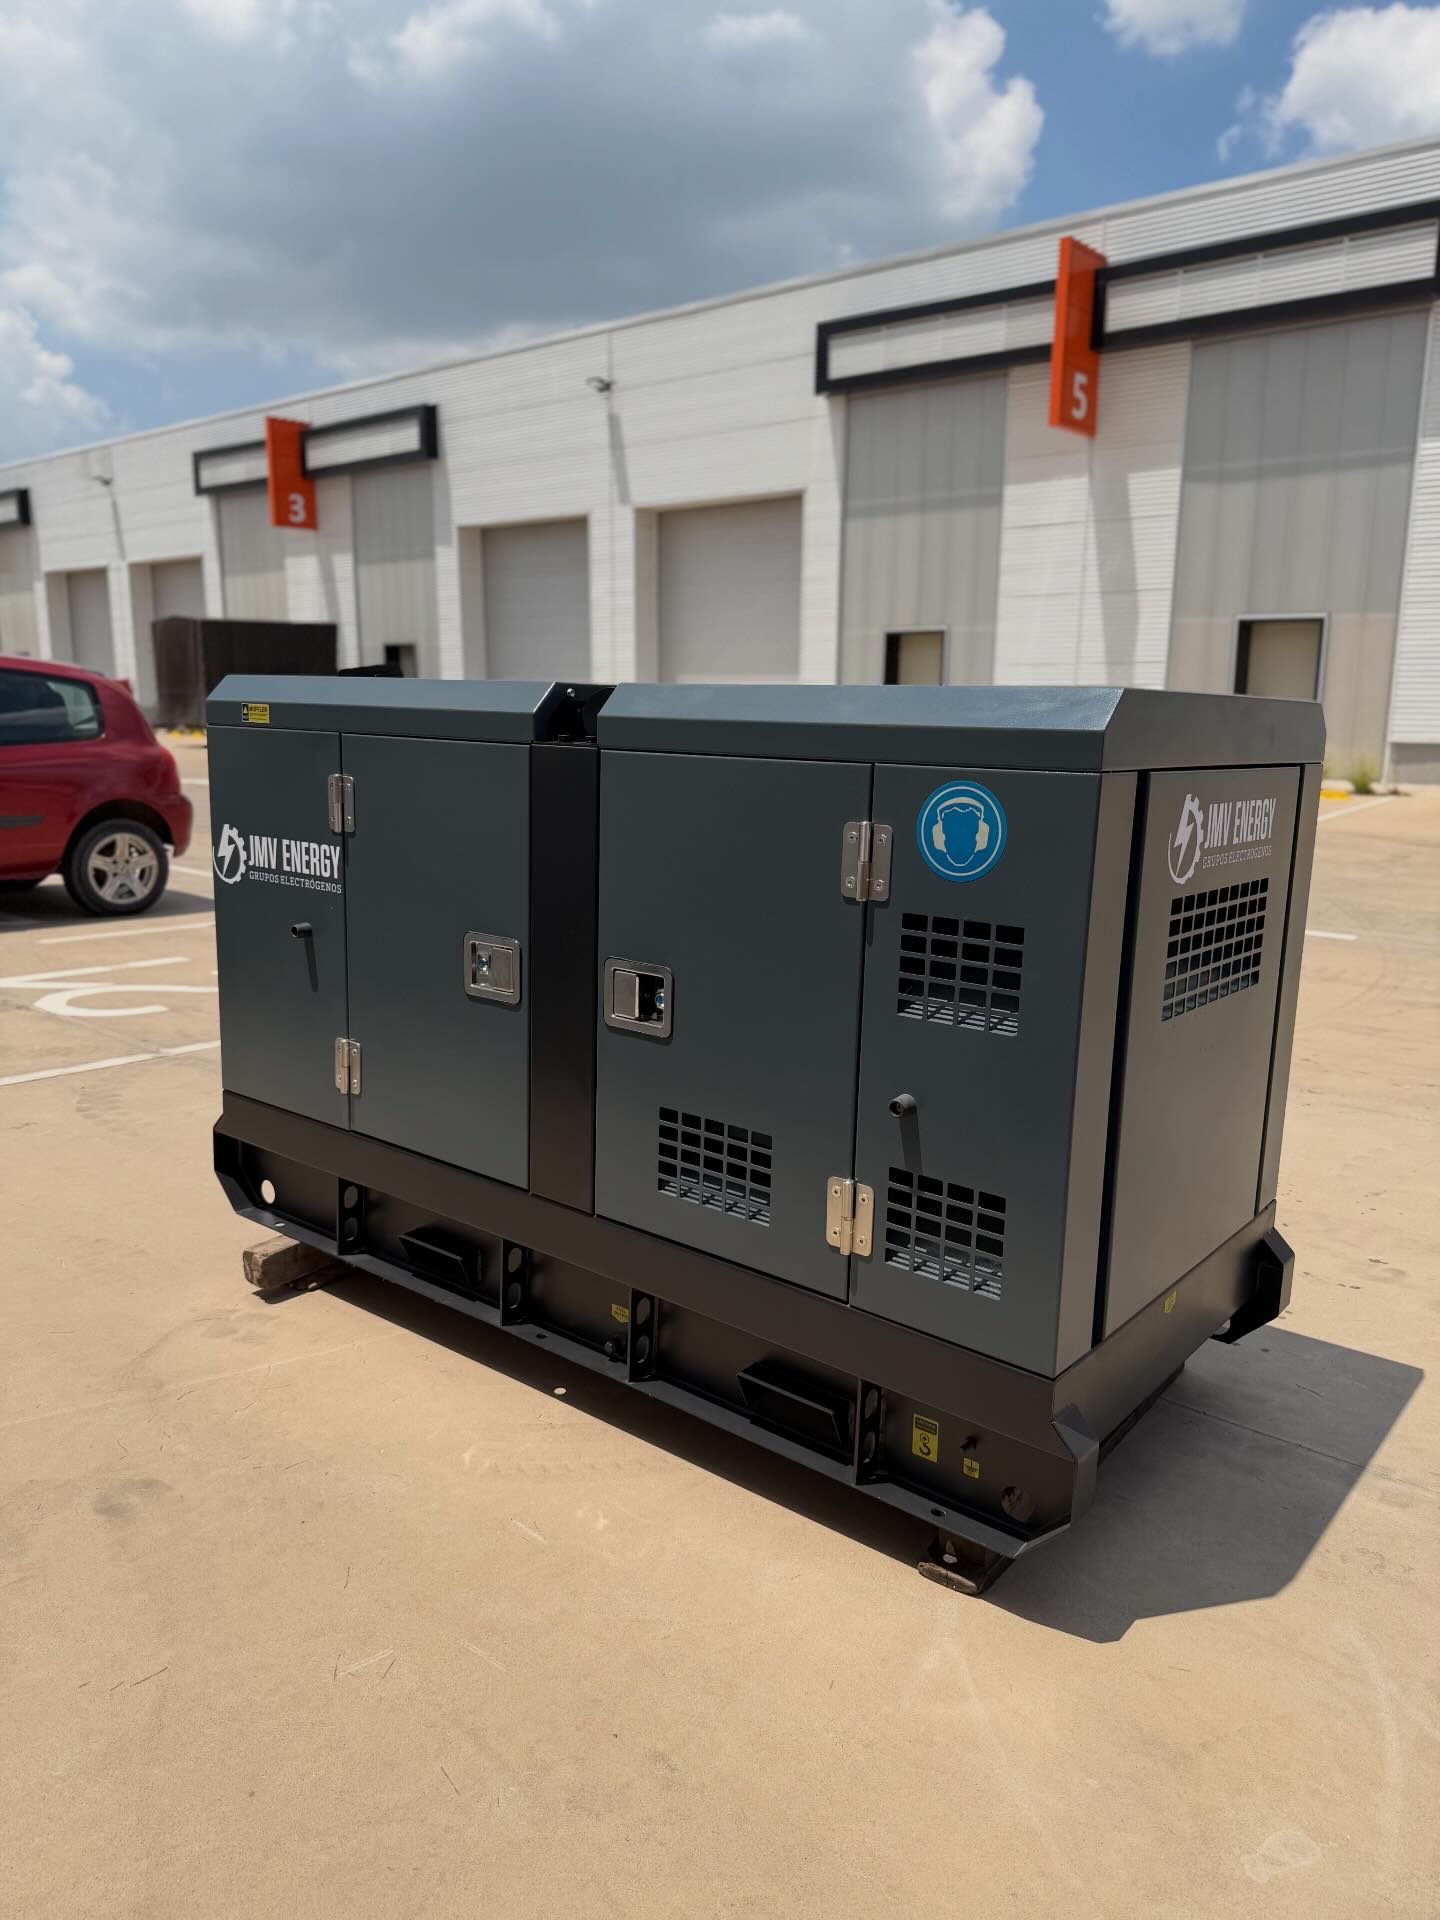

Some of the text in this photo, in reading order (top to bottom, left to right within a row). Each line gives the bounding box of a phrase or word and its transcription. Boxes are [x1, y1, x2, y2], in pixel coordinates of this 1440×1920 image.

[1072, 371, 1088, 420] 5
[287, 493, 306, 522] 3
[1204, 798, 1276, 848] JMV ENERGY
[248, 835, 340, 879] JMV ENERGY
[1202, 854, 1228, 869] GRUPOS
[249, 871, 342, 893] GRUPOS ELECTRÓGENOS
